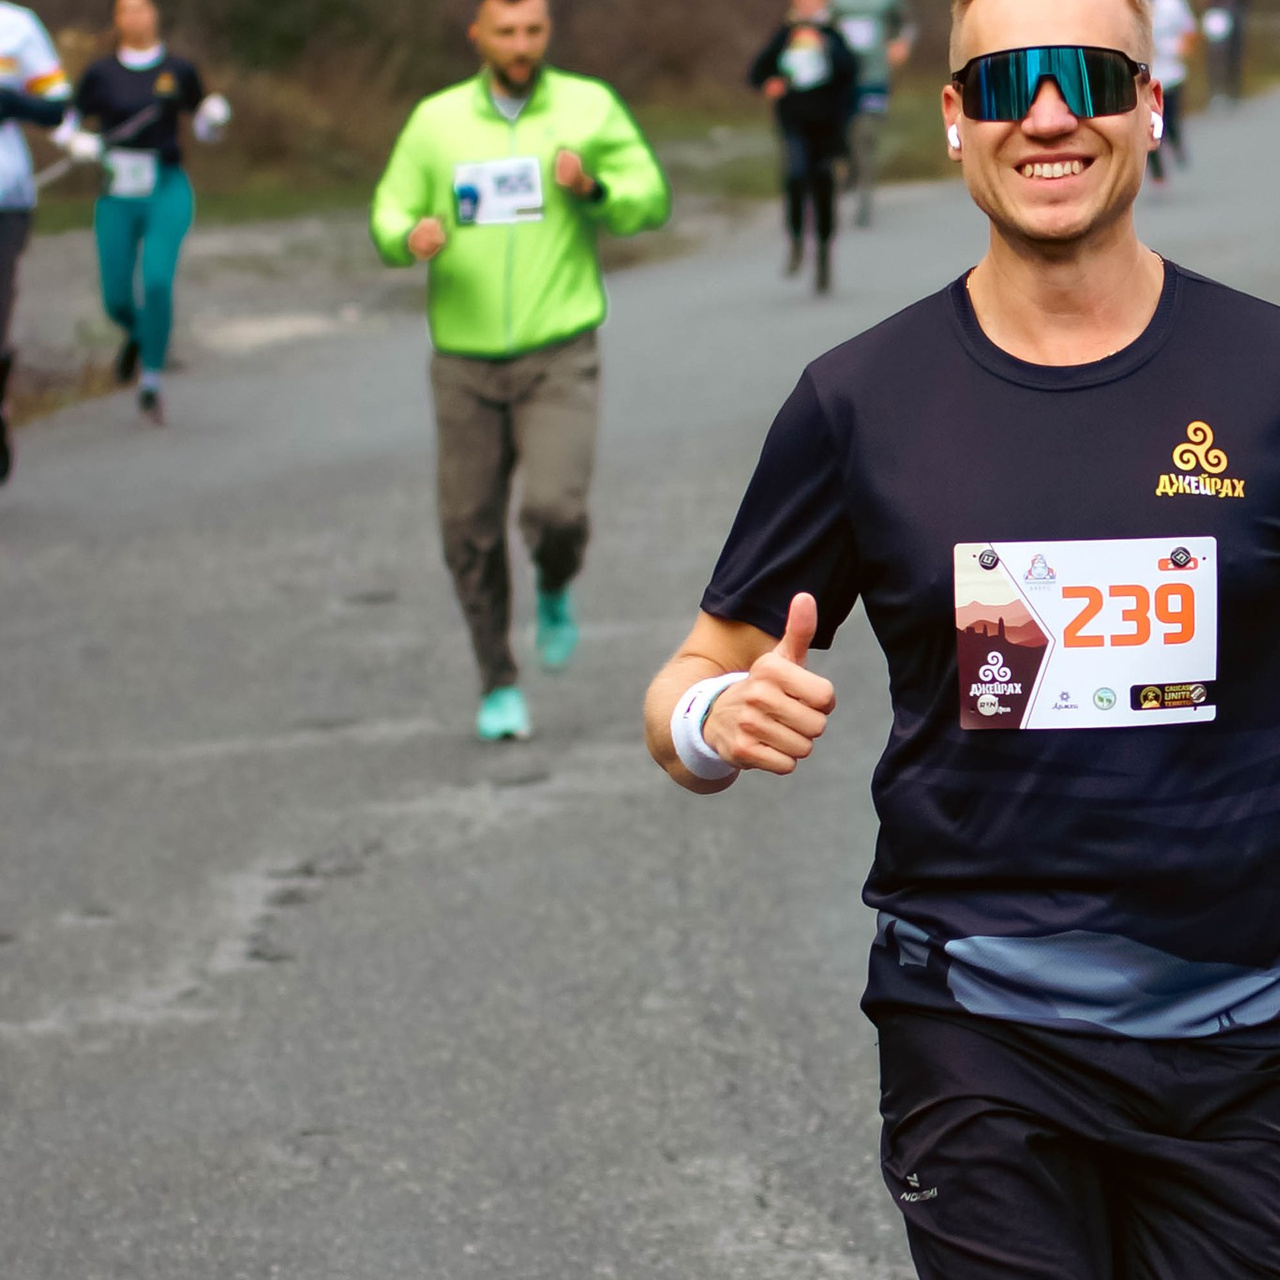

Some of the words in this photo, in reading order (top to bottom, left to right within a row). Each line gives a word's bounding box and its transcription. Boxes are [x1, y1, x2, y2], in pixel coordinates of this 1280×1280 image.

[1155, 473, 1245, 498] ДЖЕЙРАХ
[1062, 583, 1195, 648] 239
[969, 682, 1022, 697] ДЖЕЙРАХ
